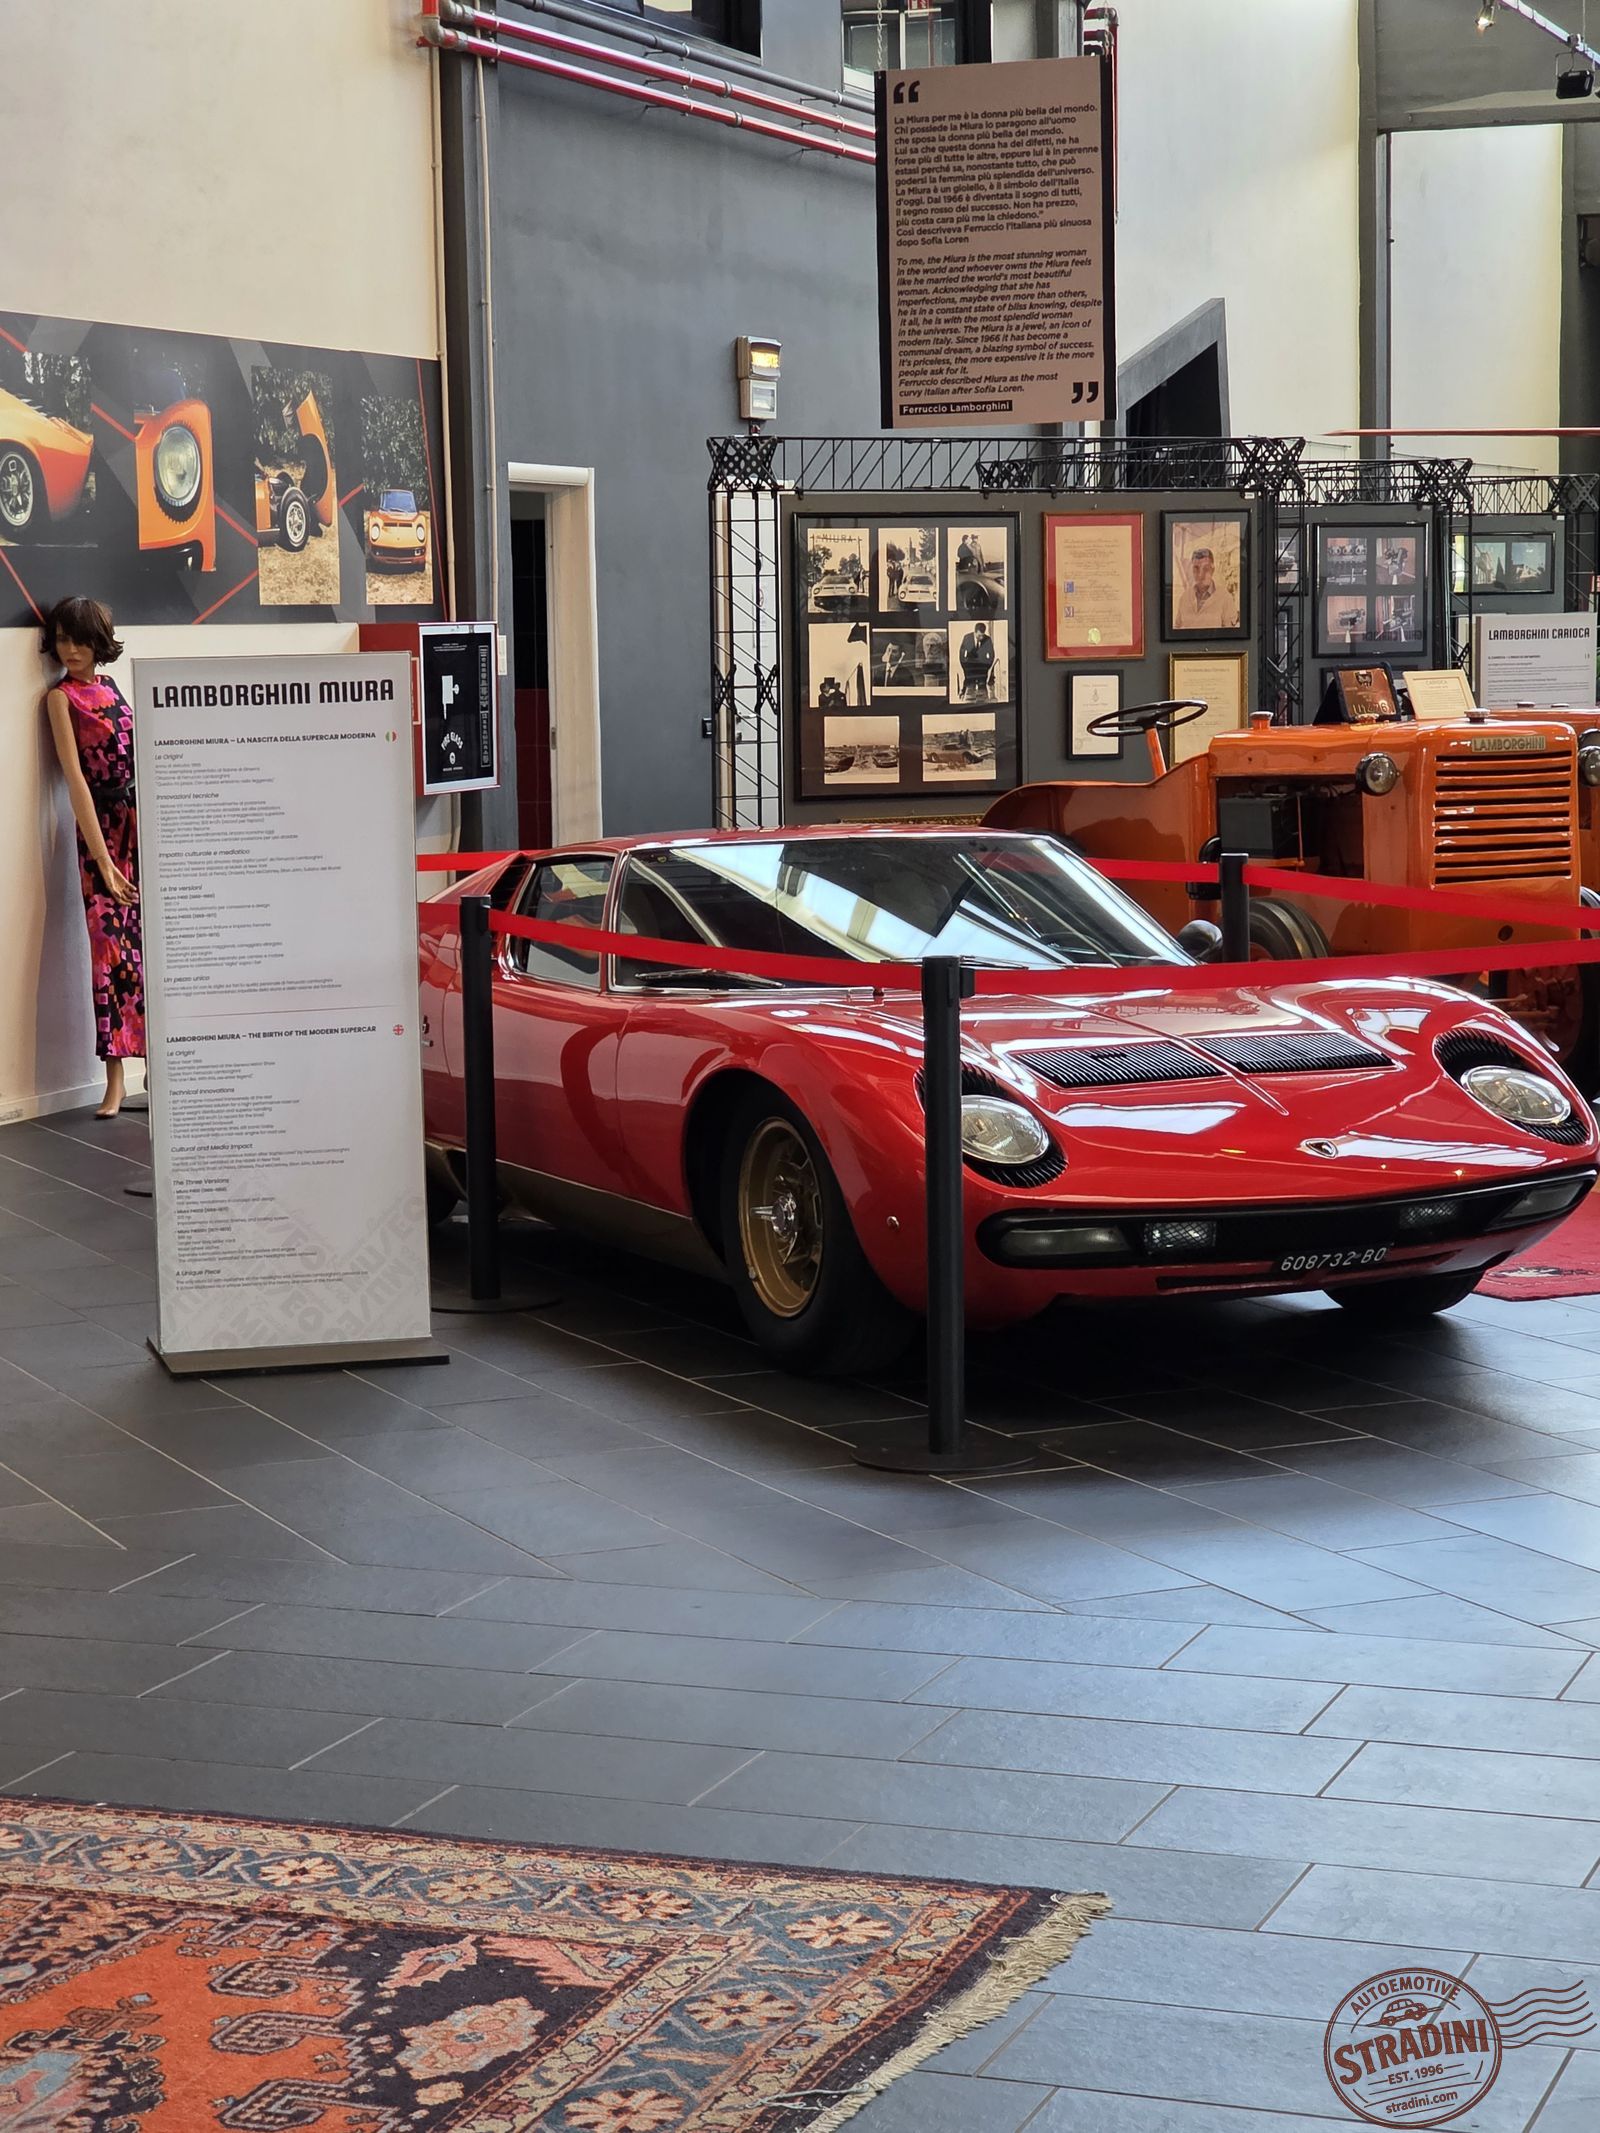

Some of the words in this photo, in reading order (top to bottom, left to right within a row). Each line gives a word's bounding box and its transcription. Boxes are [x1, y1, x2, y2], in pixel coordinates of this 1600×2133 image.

[906, 114, 929, 122] Miura
[931, 115, 946, 123] per
[980, 109, 1007, 118] donna
[1010, 108, 1023, 118] più
[1025, 106, 1046, 115] bella
[1048, 105, 1061, 113] del
[1064, 103, 1096, 112] mondo.
[894, 125, 908, 133] Chi
[910, 123, 947, 134] possiede
[959, 120, 983, 129] Miura
[995, 119, 1036, 129] paragono
[894, 135, 909, 144] che
[912, 136, 936, 144] sposa
[947, 131, 974, 140] donna
[976, 130, 989, 140] più
[992, 129, 1012, 137] bella
[1015, 128, 1028, 136] del
[1030, 126, 1063, 135] mondo.
[894, 146, 907, 154] Lui
[920, 144, 935, 152] che
[938, 142, 966, 153] questa
[968, 140, 995, 149] donna
[1010, 139, 1023, 147] dei
[1025, 137, 1053, 147] difetti,
[1068, 135, 1079, 143] ha
[894, 156, 915, 164] forse
[918, 155, 931, 164] più
[944, 152, 964, 161] tutte
[976, 150, 997, 160] altre,
[1000, 150, 1030, 159] eppure
[1062, 146, 1098, 156] perenne
[894, 166, 918, 174] estasi
[921, 164, 950, 174] perché
[966, 160, 1013, 170] nonostante
[1016, 158, 1039, 168] tutto,
[1041, 157, 1056, 165] che
[1059, 156, 1076, 166] può
[895, 175, 926, 186] godersi
[938, 172, 975, 182] femmina
[978, 171, 991, 181] più
[993, 169, 1034, 180] splendida
[908, 185, 930, 194] Miura
[953, 182, 986, 193] gioiello,
[1004, 179, 1037, 188] simbolo
[943, 194, 962, 202] 1966
[972, 191, 1012, 200] diventata
[1022, 190, 1048, 199] sogno
[1061, 186, 1082, 196] tutti,
[902, 208, 928, 216] segno
[1013, 200, 1030, 208] Non
[1045, 199, 1077, 208] prezzo,
[896, 237, 918, 247] dopo
[921, 236, 942, 244] Sofia
[944, 234, 968, 243] Loren
[902, 403, 947, 414] Ferruccio
[950, 402, 1010, 413] Lamborghini
[1489, 629, 1549, 641] LAMBORGHINI
[1552, 627, 1590, 639] CARIOCA
[153, 684, 311, 708] LAMBORGHINI
[319, 679, 394, 703] MIURA
[1474, 736, 1544, 751] LAMBORGHINI
[166, 1034, 216, 1043] LAMBORGHINI
[181, 1269, 203, 1277] Unique
